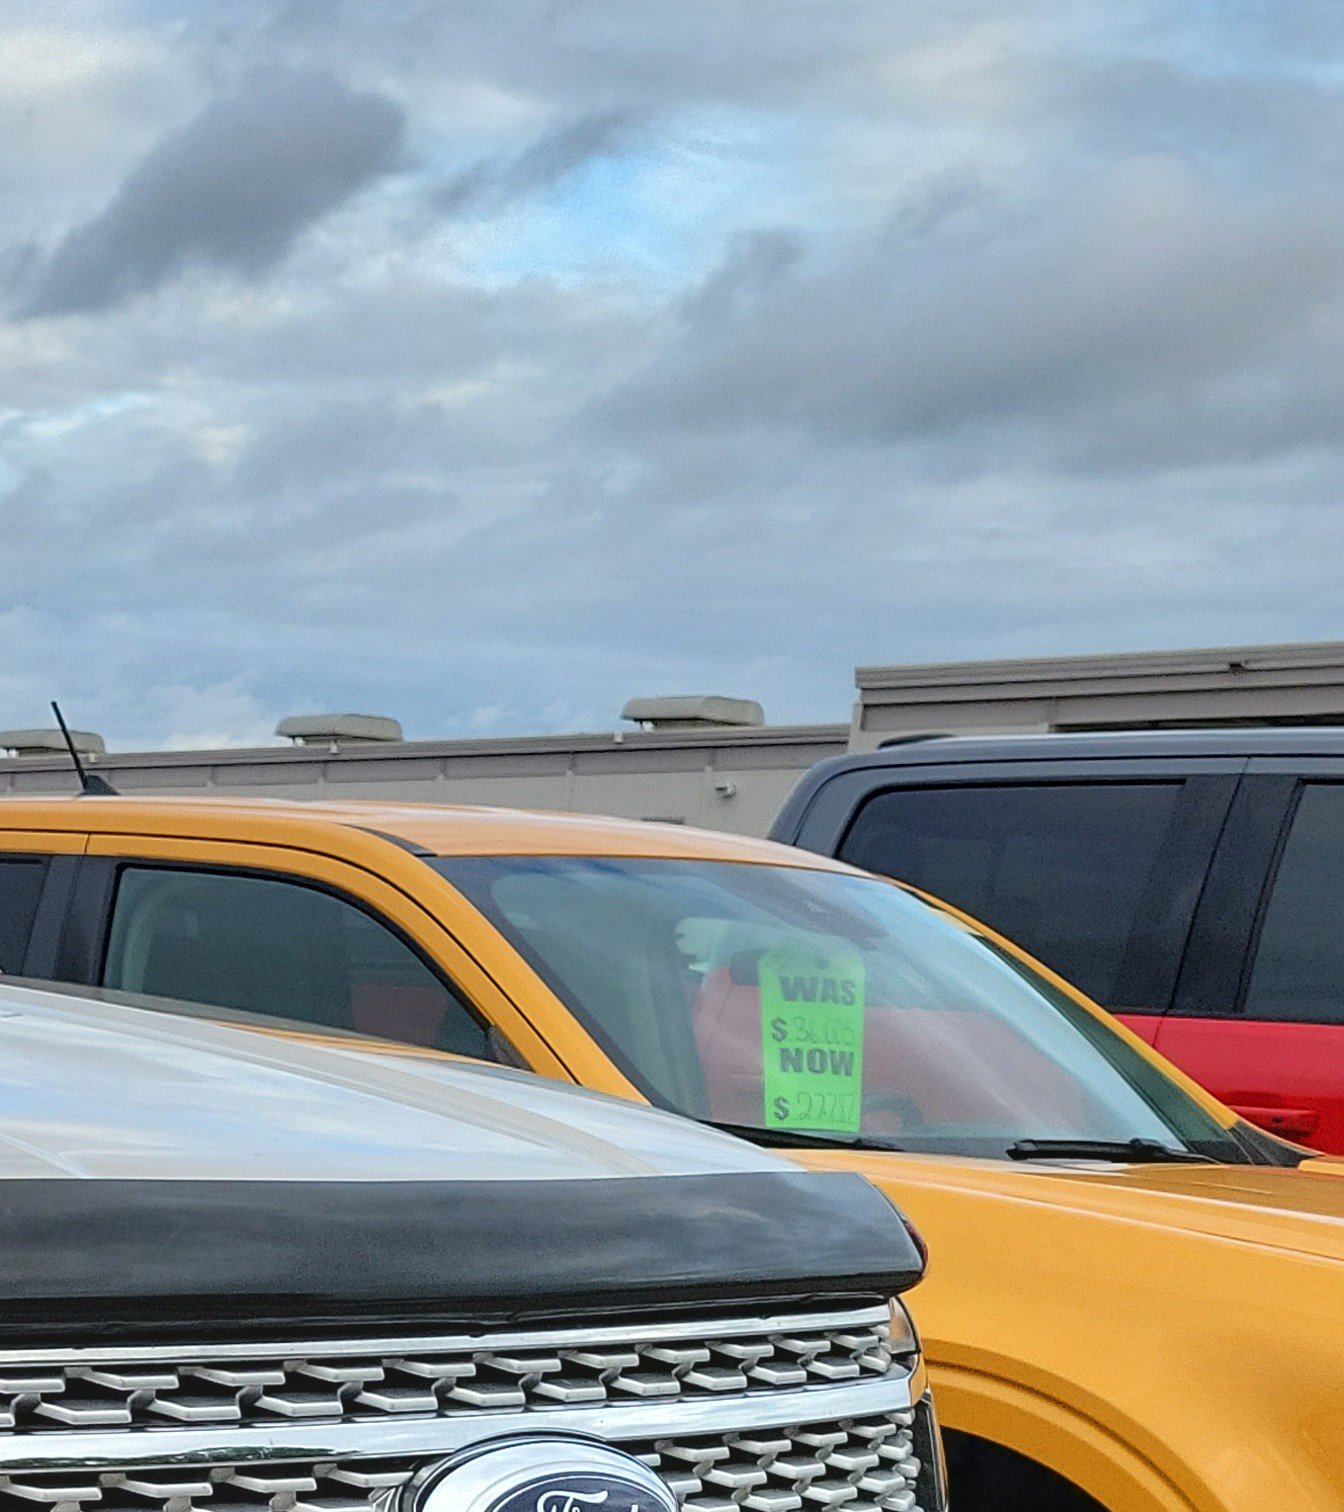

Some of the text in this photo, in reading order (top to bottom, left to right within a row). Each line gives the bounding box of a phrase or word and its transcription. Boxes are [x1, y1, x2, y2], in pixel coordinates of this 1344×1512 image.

[780, 976, 856, 1006] WAS
[771, 1016, 788, 1042] $
[779, 1046, 856, 1077] NOW
[773, 1095, 789, 1121] $
